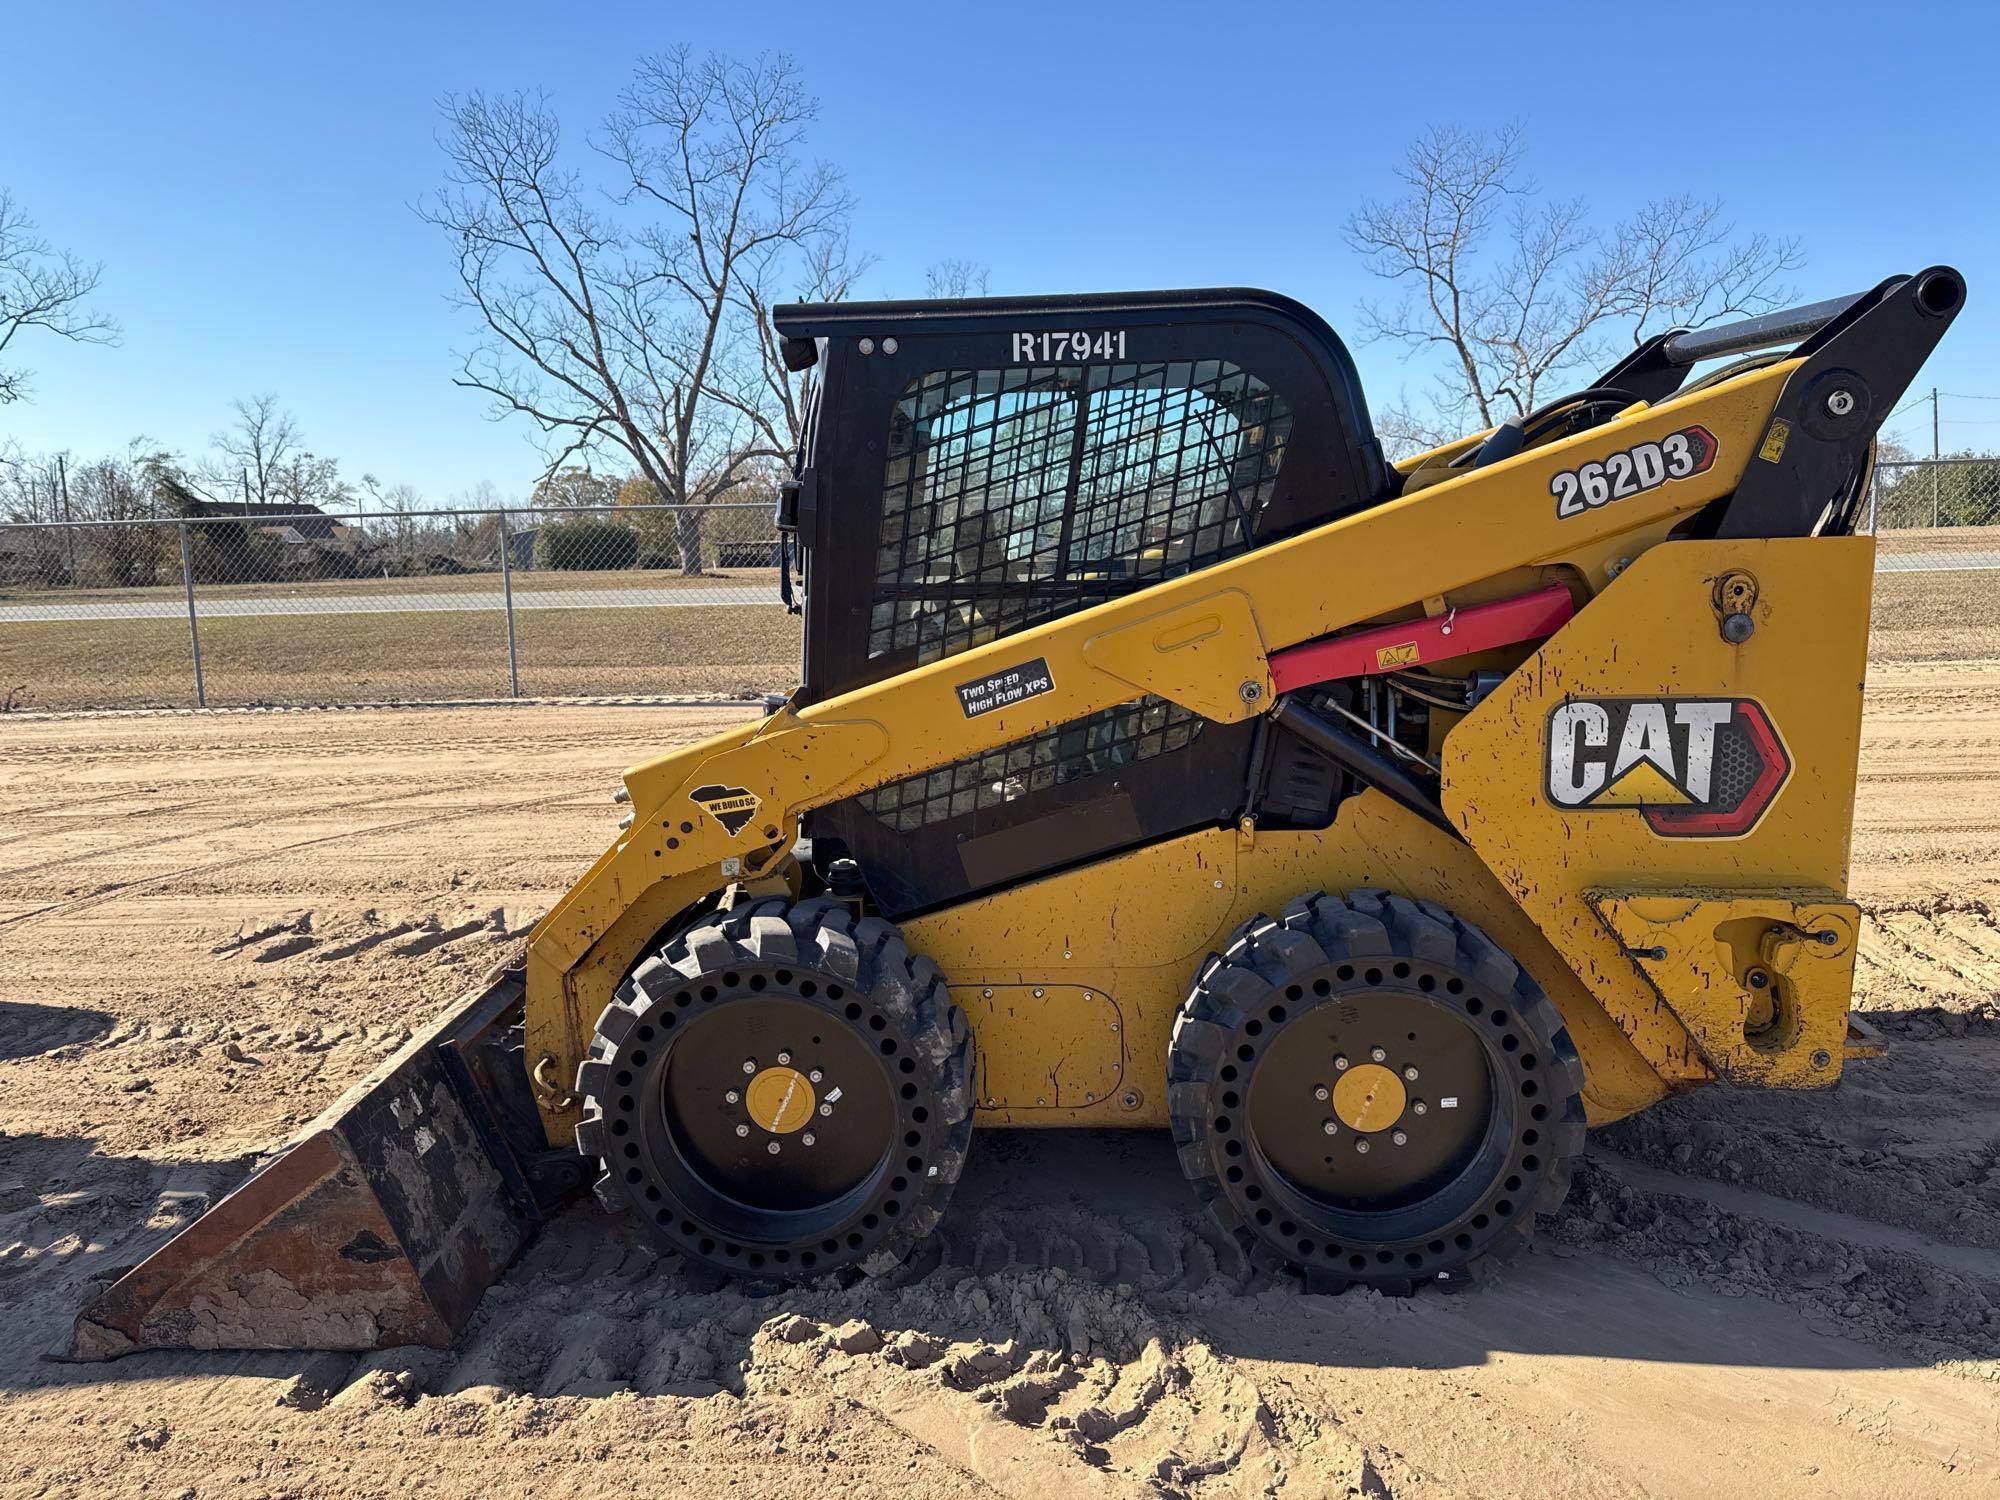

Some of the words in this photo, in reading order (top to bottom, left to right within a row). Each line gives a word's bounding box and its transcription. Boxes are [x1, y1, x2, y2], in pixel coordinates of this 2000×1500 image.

[1012, 330, 1125, 362] R17941
[1552, 434, 1694, 516] 262D3
[961, 684, 985, 700] TWO
[968, 697, 993, 714] HIGH
[995, 687, 1023, 705] FLOW
[1025, 676, 1048, 695] XPS
[1550, 702, 1732, 804] CAT
[708, 802, 721, 812] WE
[722, 799, 745, 810] BUILD
